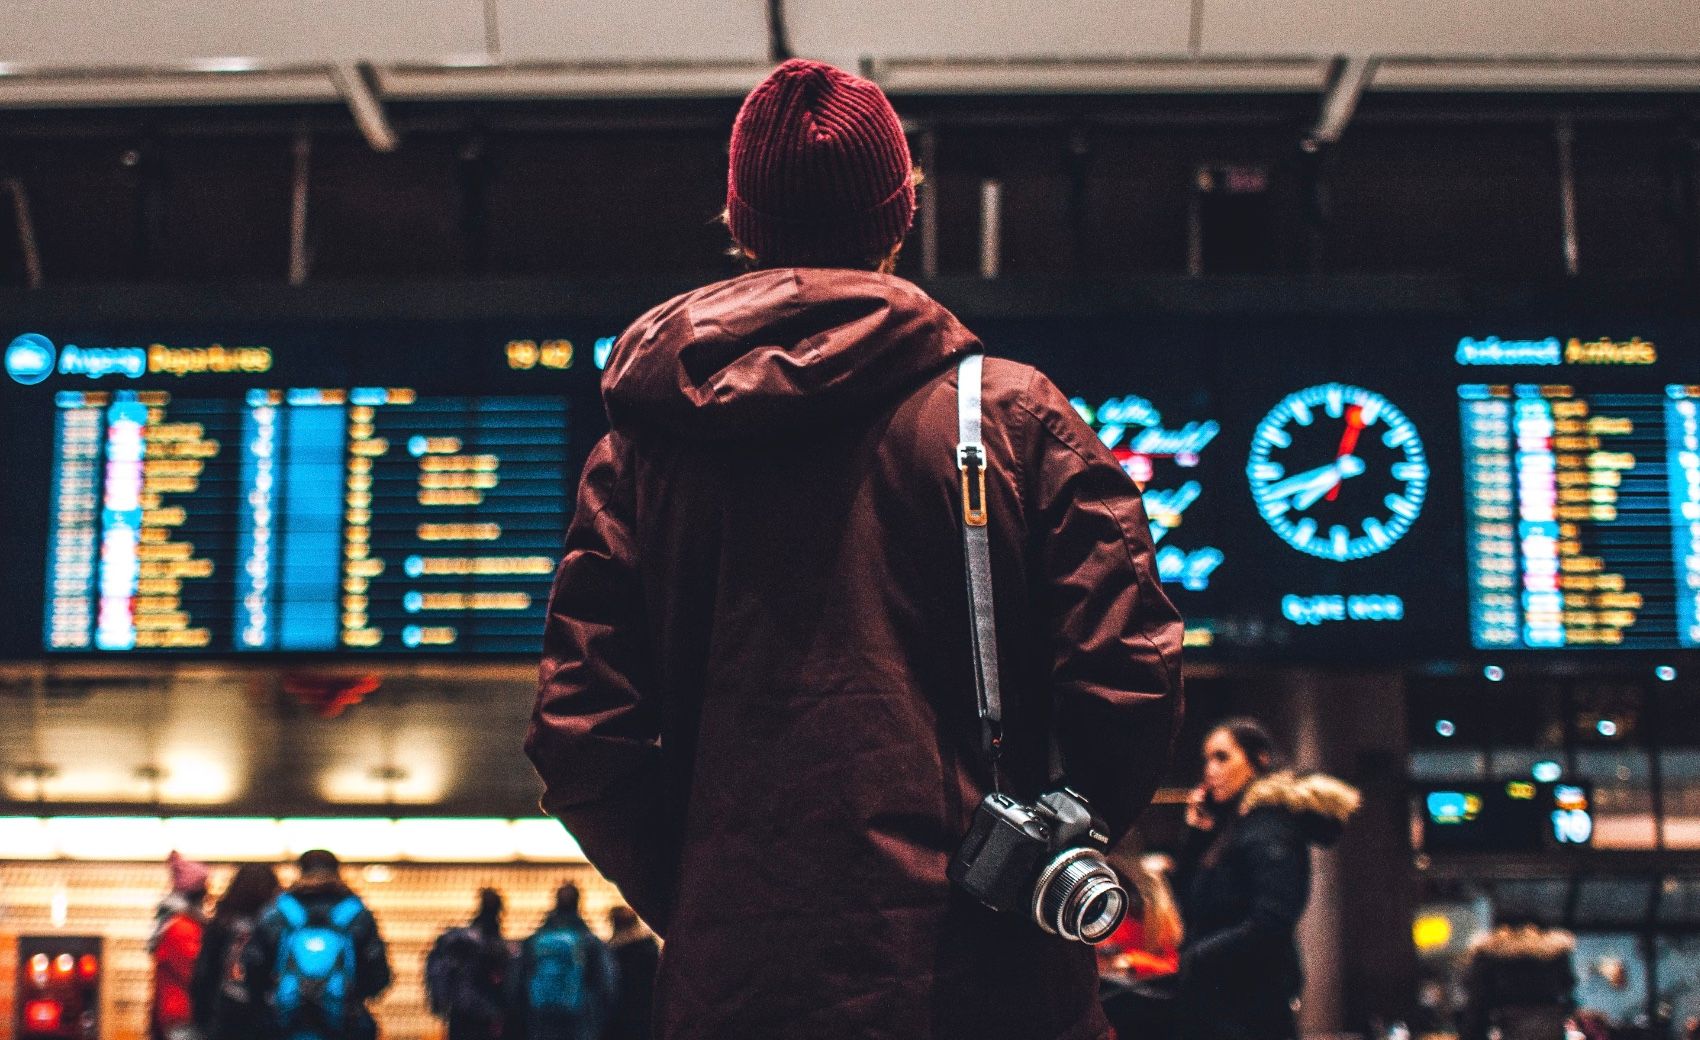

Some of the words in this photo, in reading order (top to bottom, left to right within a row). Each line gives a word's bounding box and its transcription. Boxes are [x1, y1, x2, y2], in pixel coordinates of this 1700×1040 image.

[149, 344, 272, 376] Departures
[1566, 337, 1657, 364] Arrivals
[1089, 829, 1109, 844] Canon
